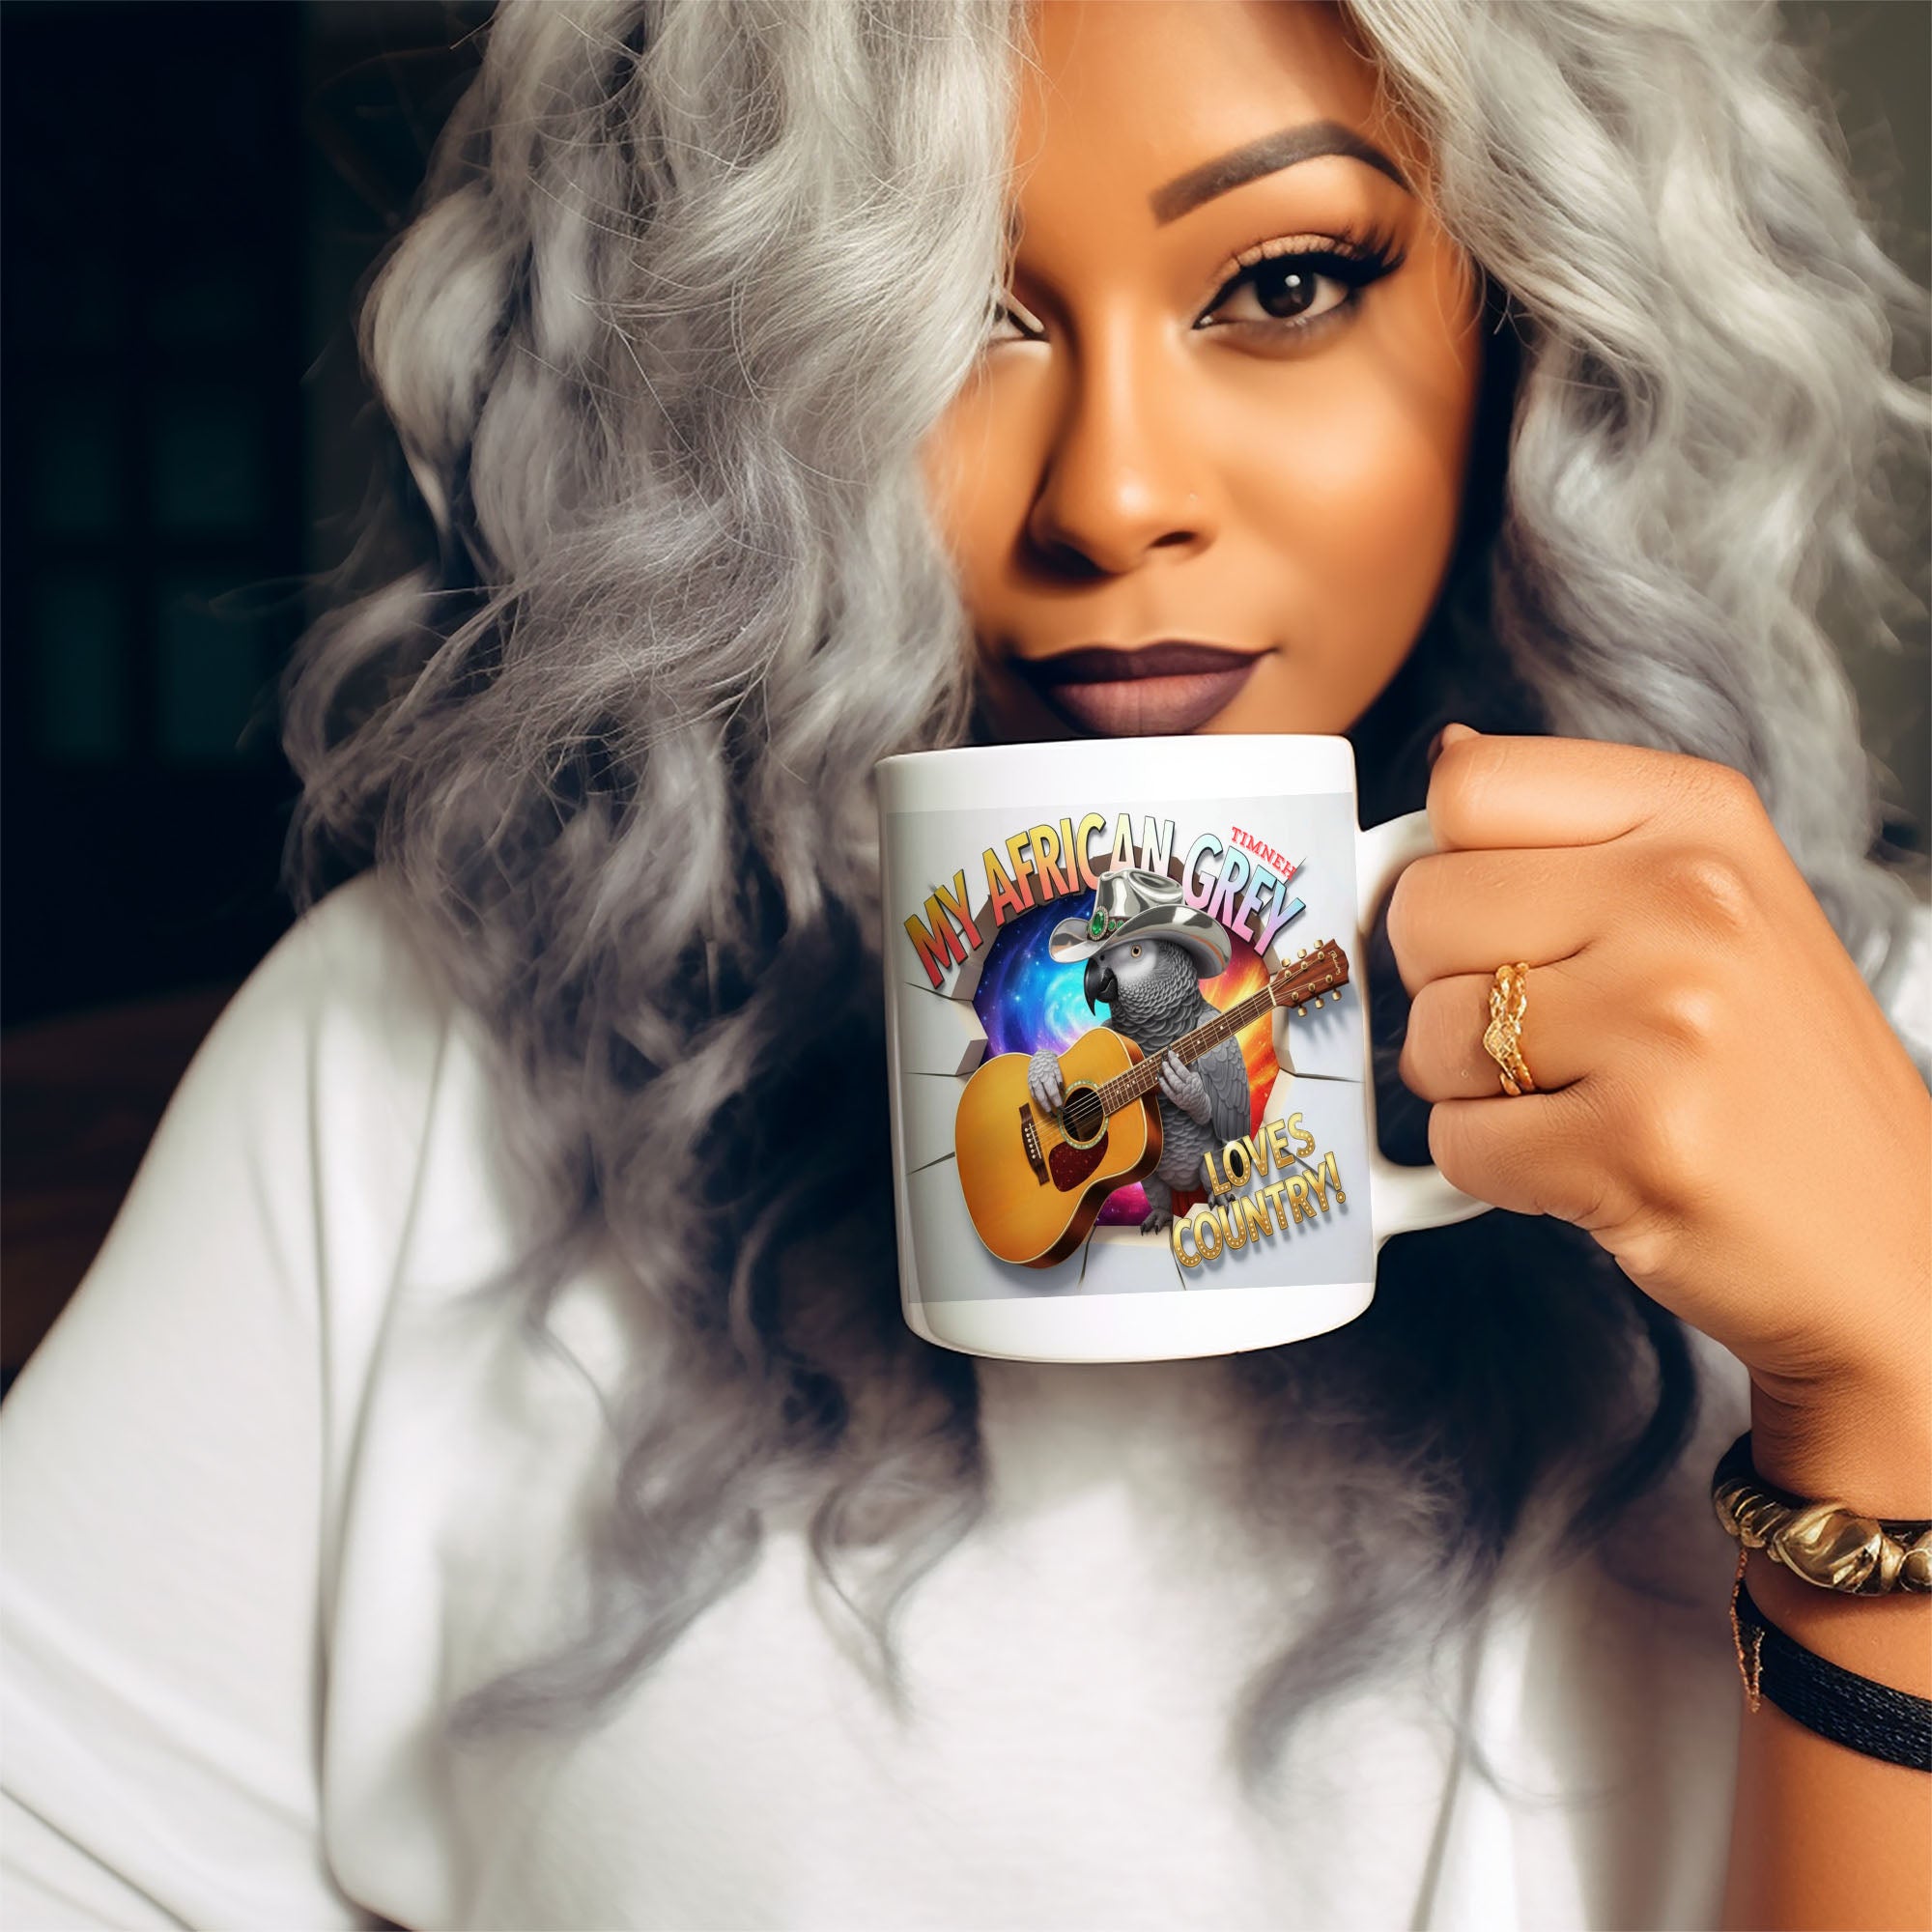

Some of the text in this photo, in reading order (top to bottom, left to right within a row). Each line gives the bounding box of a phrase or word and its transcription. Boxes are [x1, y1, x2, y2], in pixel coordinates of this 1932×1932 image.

[903, 812, 1307, 990] MY AFRICAN GREY
[1231, 826, 1298, 882] TIMNEH
[1204, 1112, 1316, 1197] LOVES
[1173, 1151, 1347, 1267] COUNTRY!
